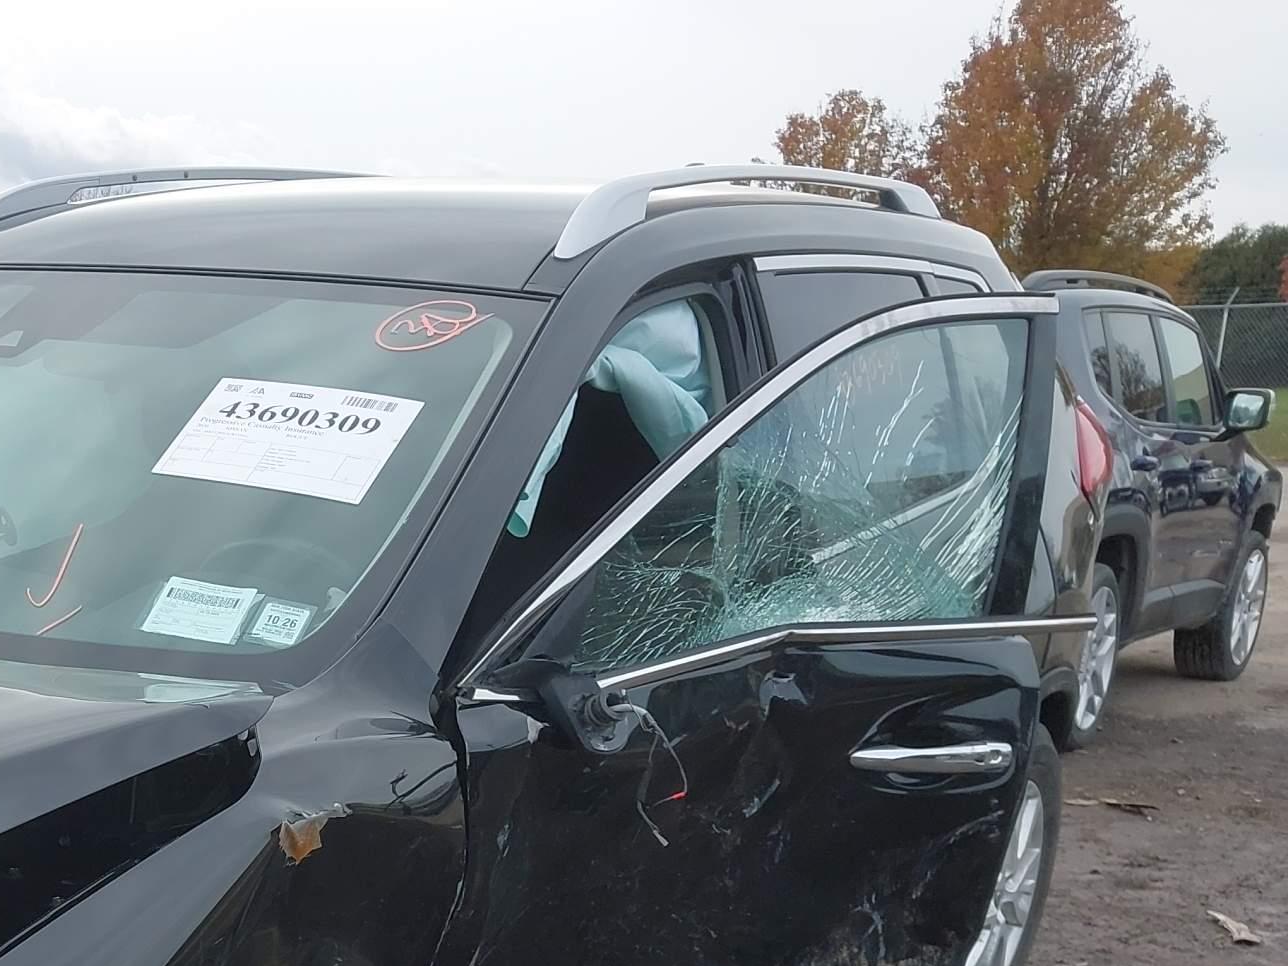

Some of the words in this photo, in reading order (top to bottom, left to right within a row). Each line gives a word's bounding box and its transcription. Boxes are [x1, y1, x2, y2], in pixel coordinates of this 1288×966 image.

[219, 401, 381, 435] 43690309
[267, 614, 280, 625] 10
[281, 617, 298, 628] 26
